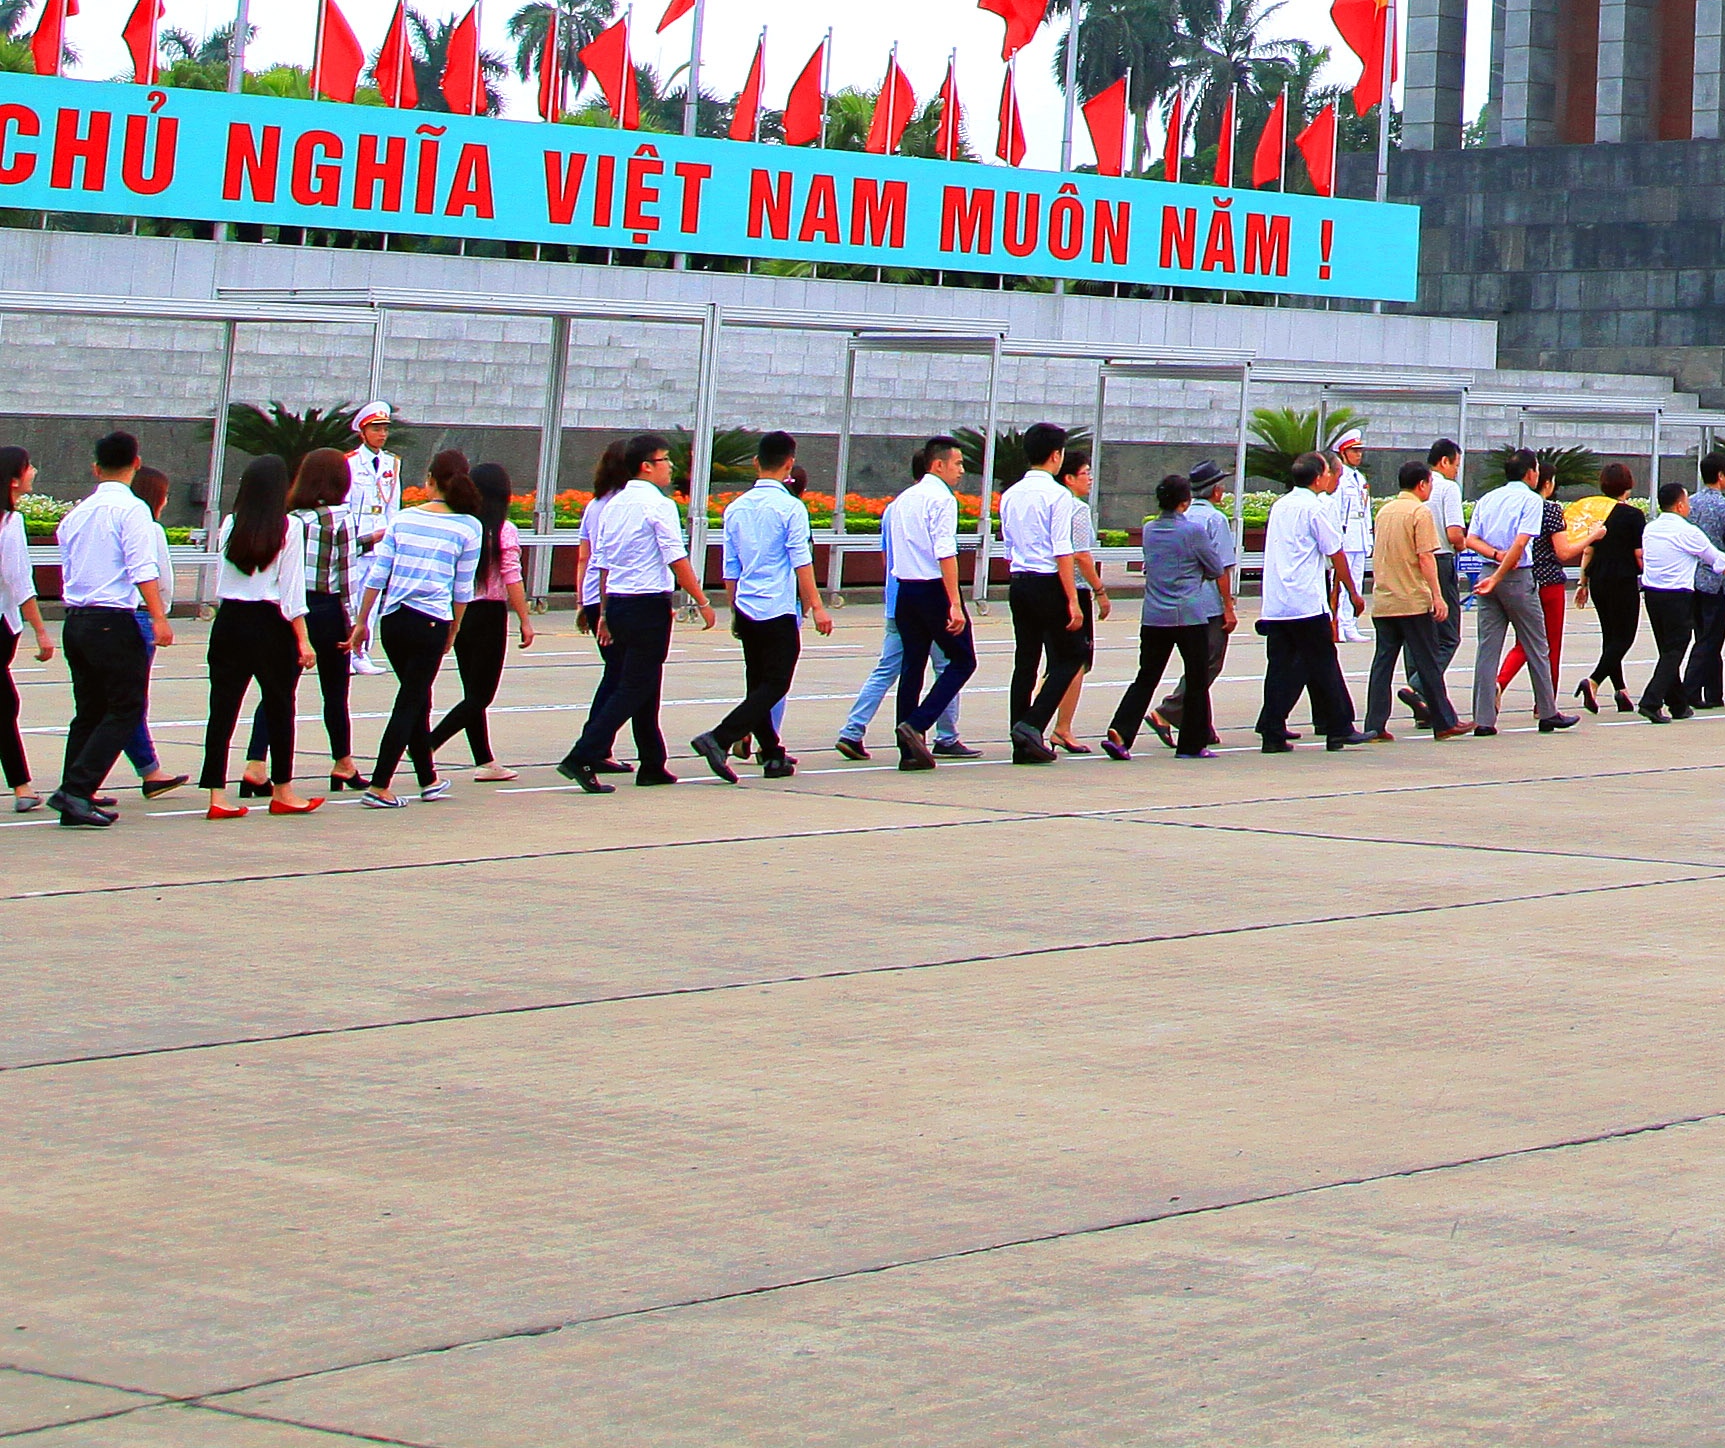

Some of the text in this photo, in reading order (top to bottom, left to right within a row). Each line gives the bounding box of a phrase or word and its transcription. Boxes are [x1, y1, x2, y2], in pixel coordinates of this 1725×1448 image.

[0, 91, 179, 196] CHỦ
[222, 123, 494, 220] NGHĨA
[544, 143, 712, 244] VIỆT
[747, 169, 908, 249] NAM
[939, 182, 1131, 266] MUÔN
[1159, 196, 1291, 278] NĂM
